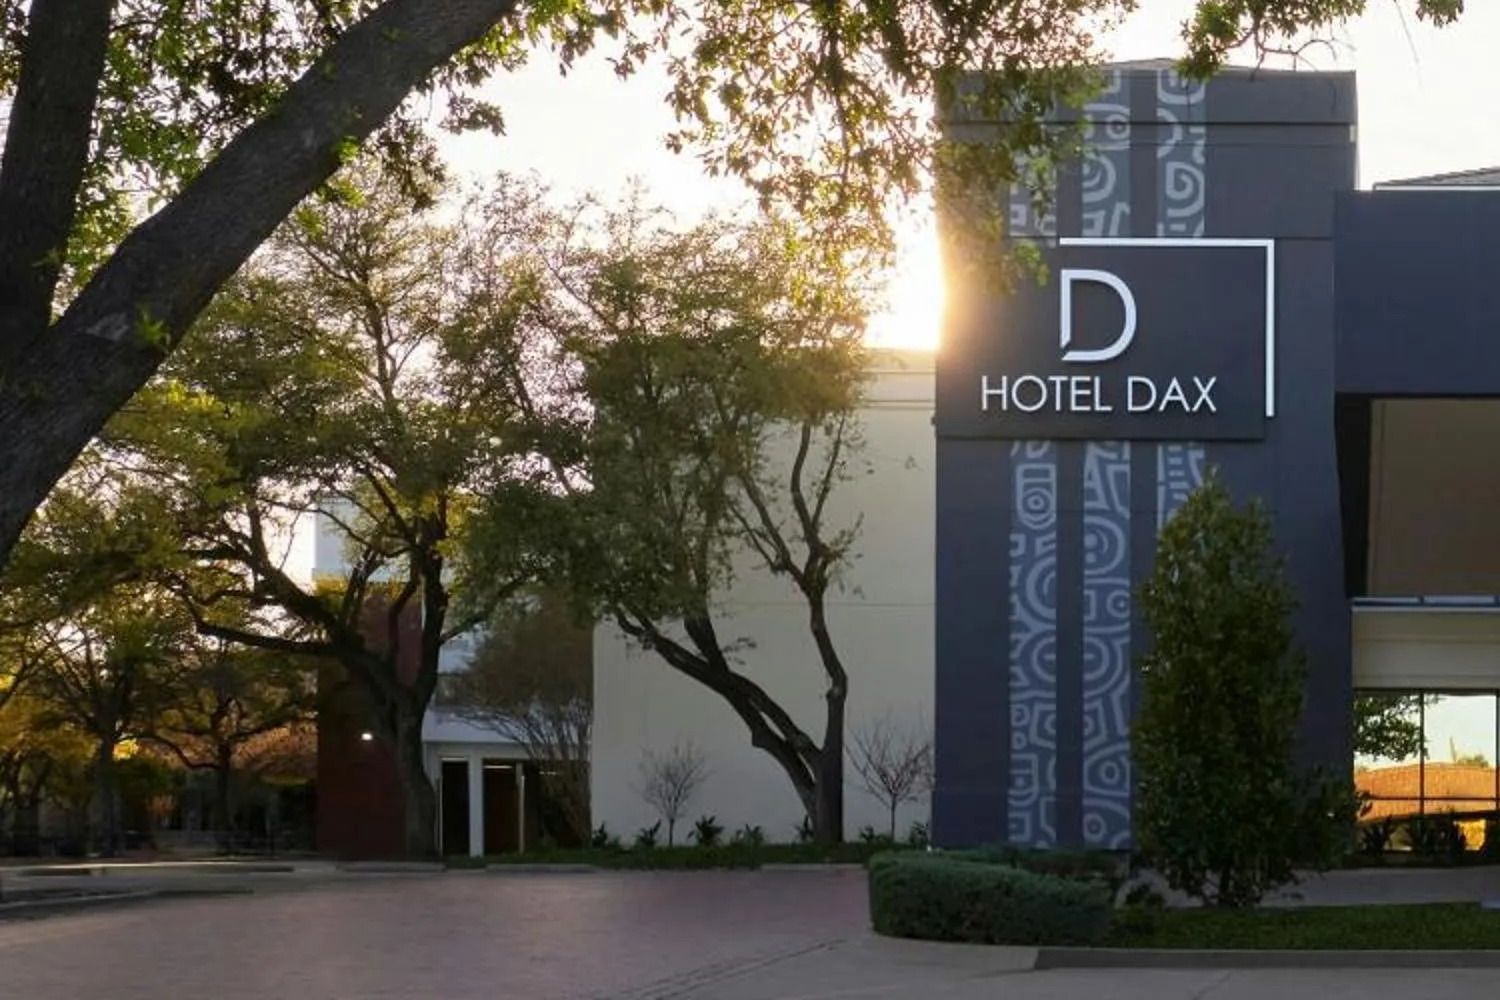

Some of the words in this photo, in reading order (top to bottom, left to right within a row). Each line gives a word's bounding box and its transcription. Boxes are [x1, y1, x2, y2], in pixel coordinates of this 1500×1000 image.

[1060, 268, 1137, 362] D
[980, 374, 1113, 412] HOTEL
[1127, 376, 1218, 413] DAX
